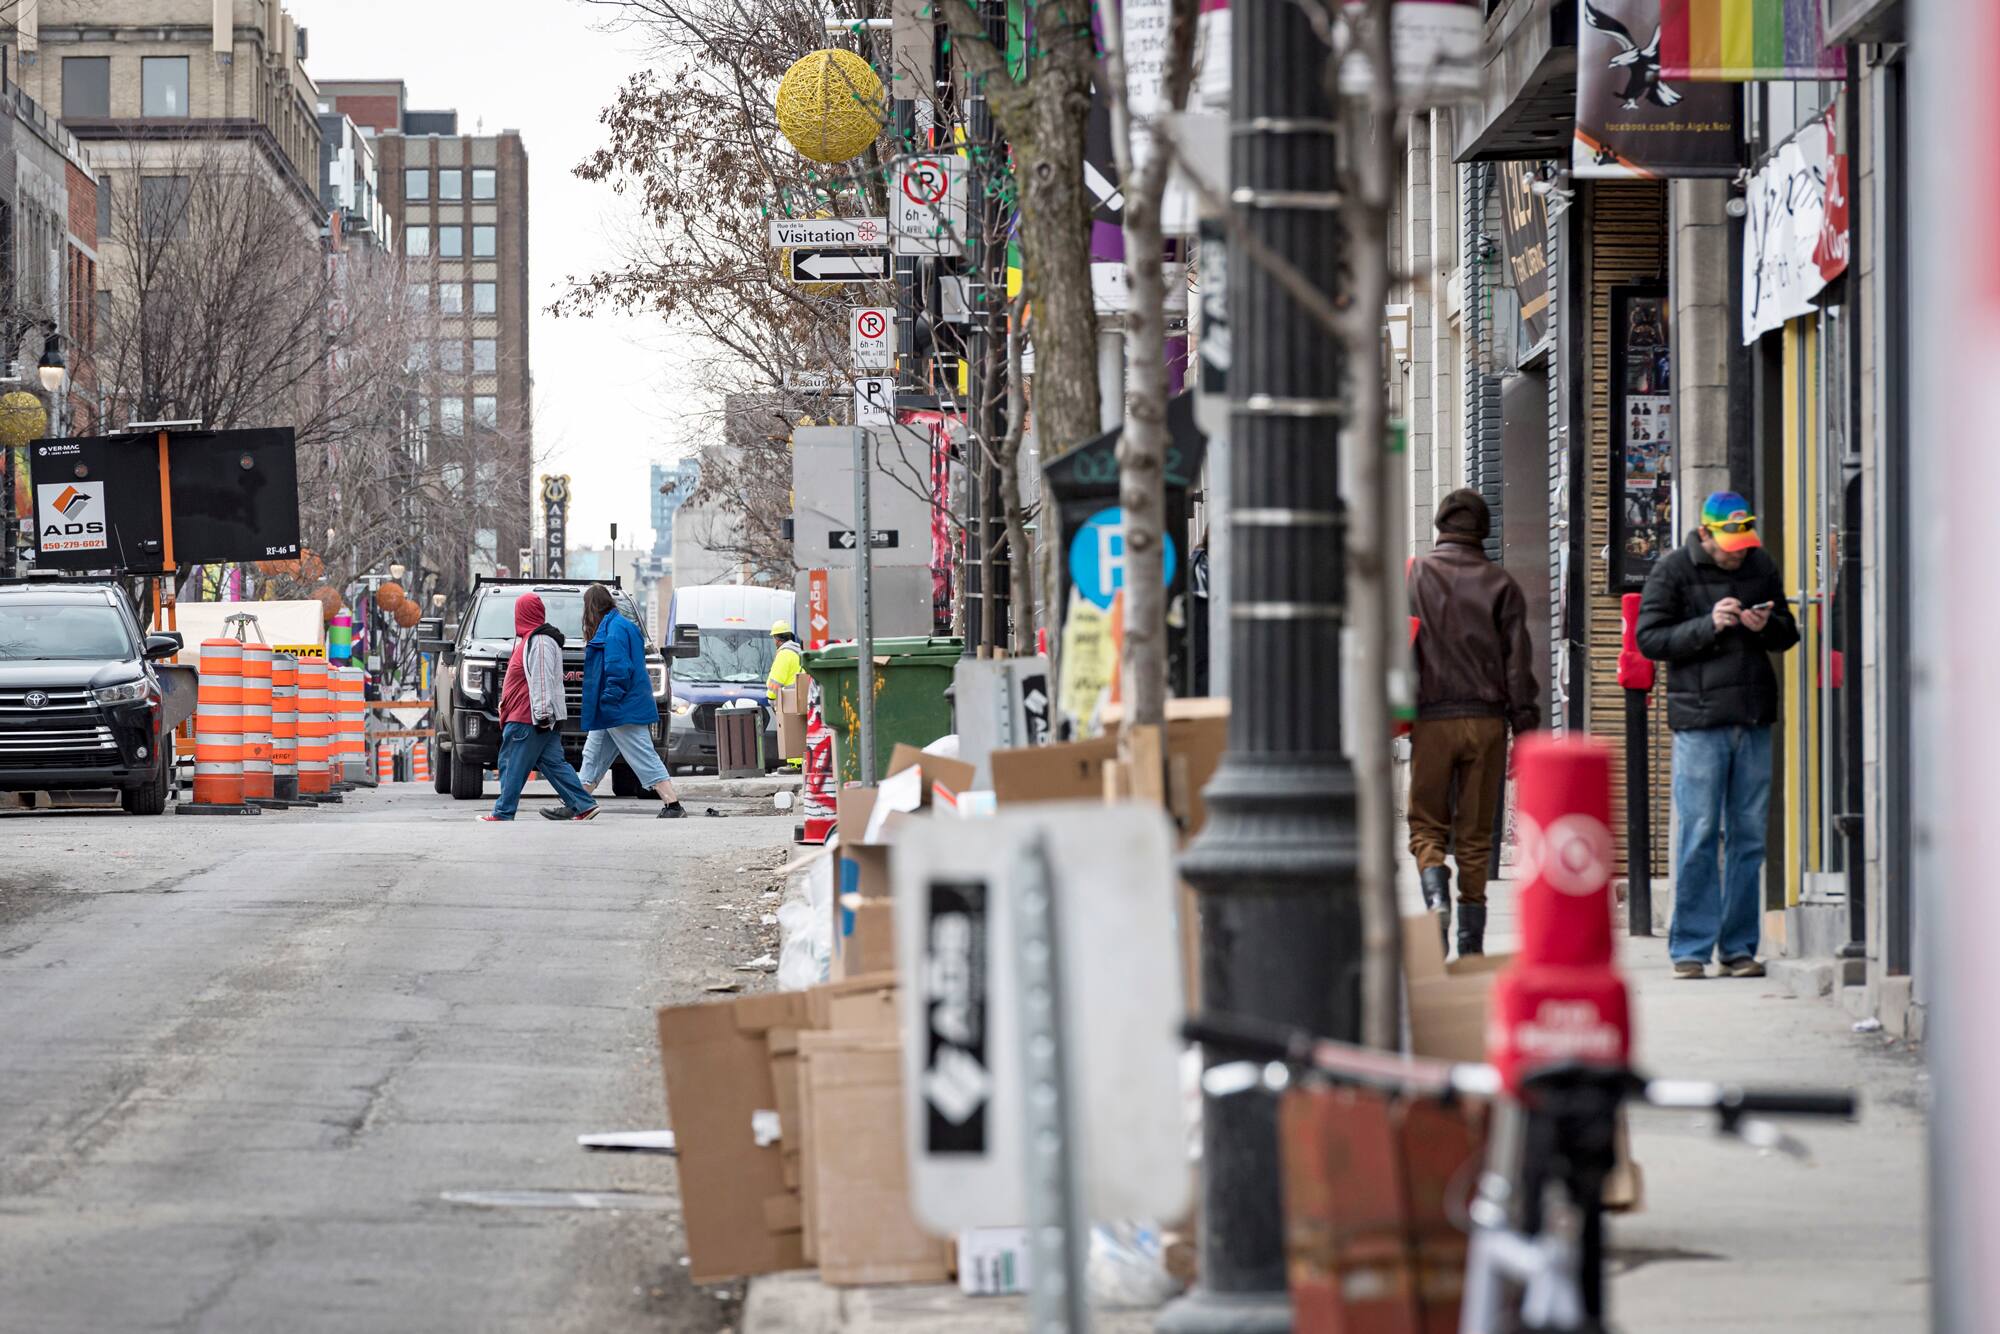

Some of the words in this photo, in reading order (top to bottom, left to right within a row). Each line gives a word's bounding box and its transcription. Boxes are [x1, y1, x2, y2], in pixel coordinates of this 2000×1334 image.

[777, 228, 855, 243] Visitation
[867, 382, 881, 402] P
[863, 405, 869, 414] 5
[43, 522, 104, 537] ADS
[43, 540, 105, 550] 450-279-6021
[549, 503, 562, 579] ARCHA
[266, 546, 287, 555] RF-46
[562, 671, 585, 681] MC
